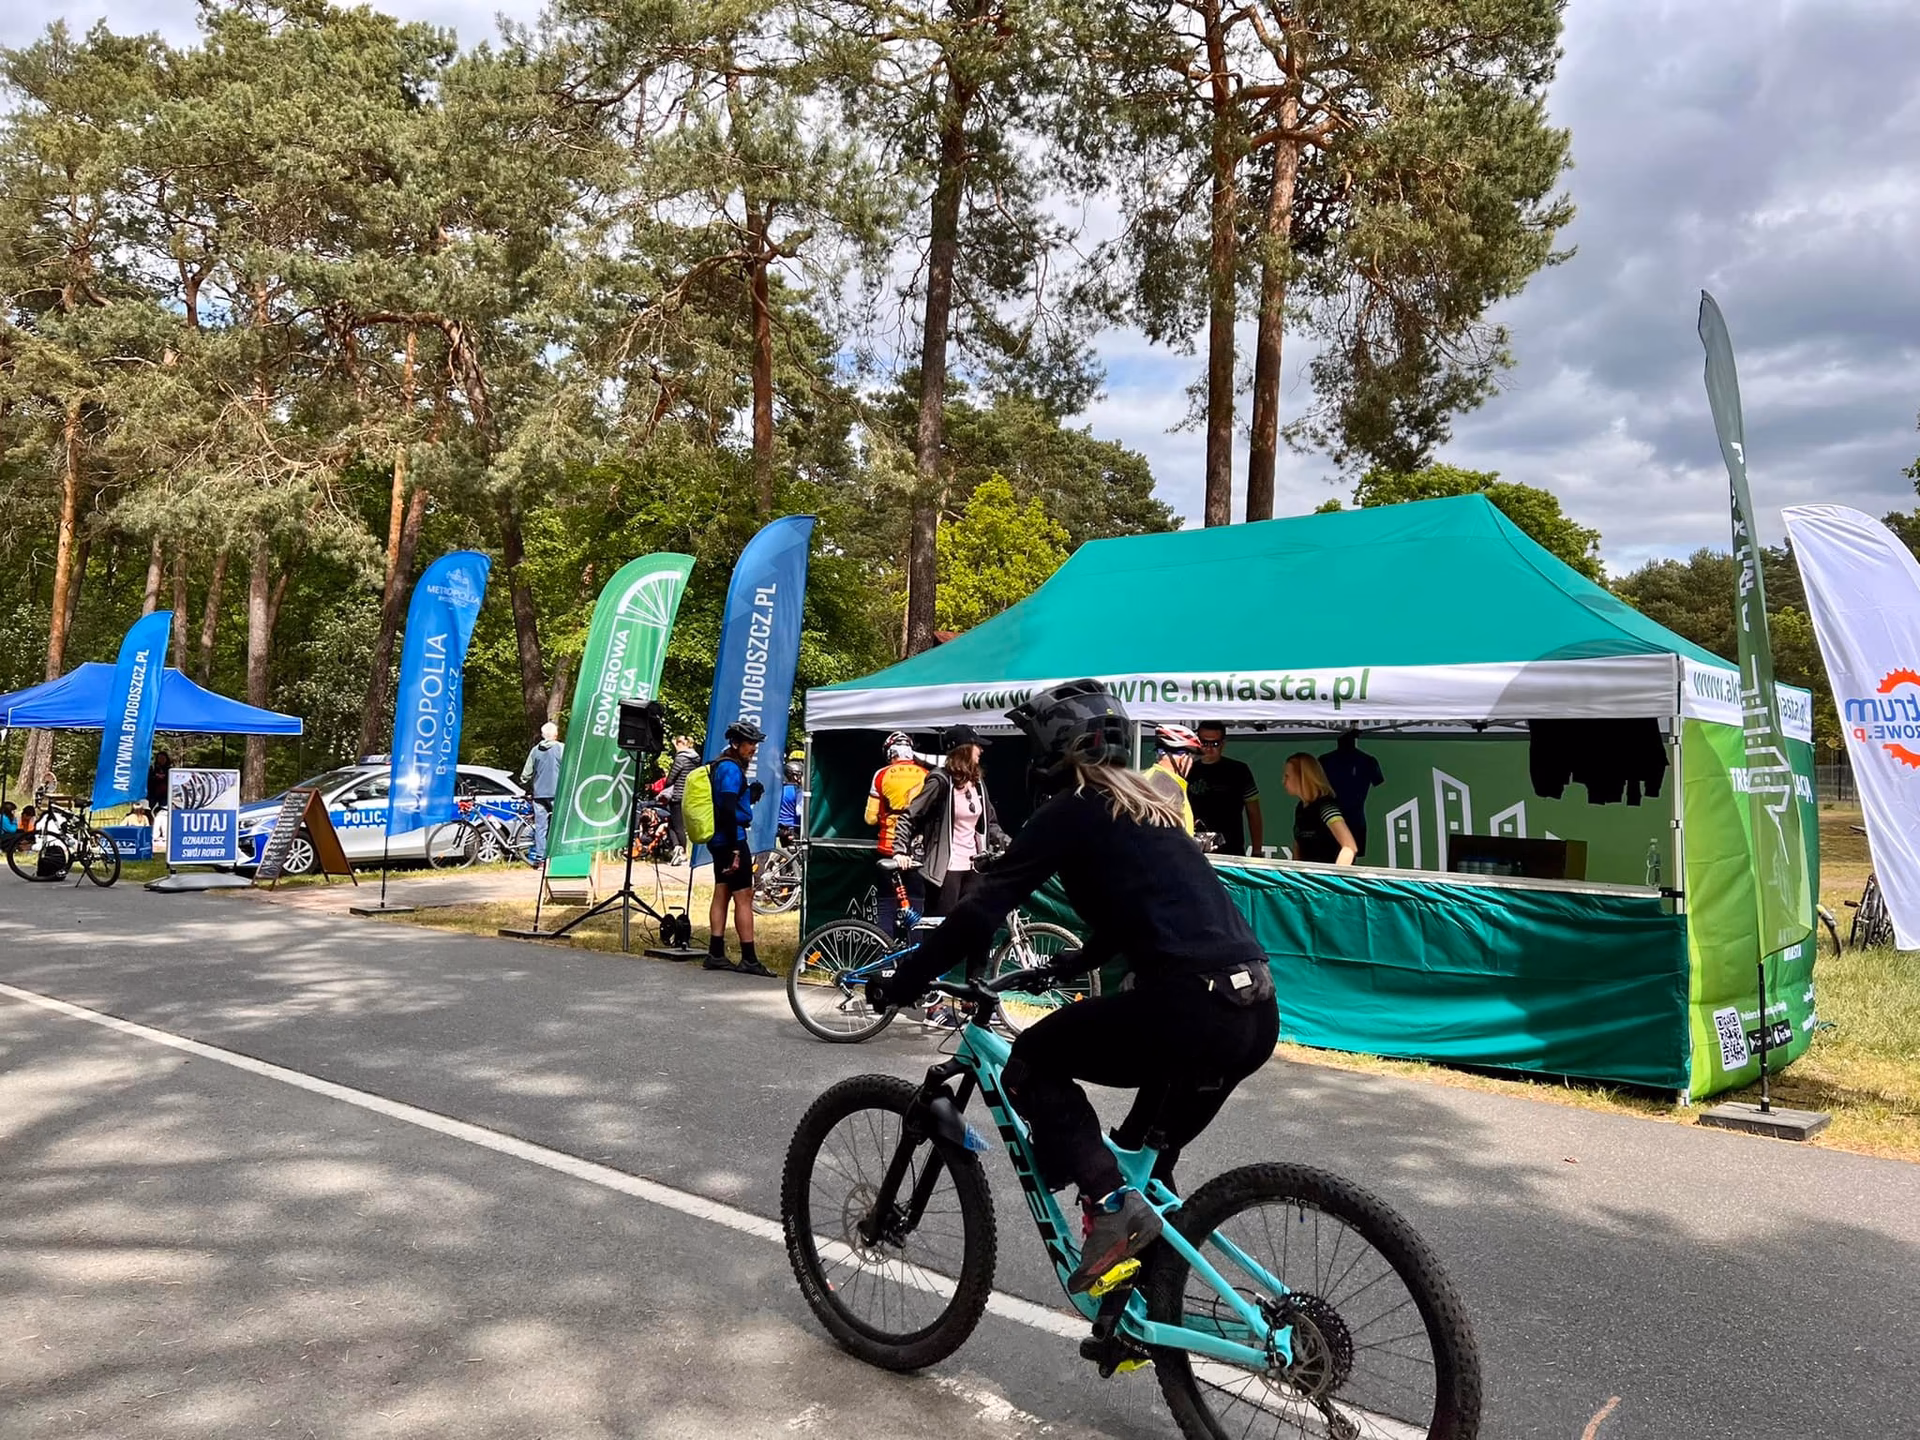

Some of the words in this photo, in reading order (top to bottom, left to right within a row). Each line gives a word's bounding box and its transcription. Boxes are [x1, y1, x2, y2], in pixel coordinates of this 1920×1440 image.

[112, 649, 150, 792] AKTYWNA.BYDGOSZCZ.PL
[592, 629, 631, 737] ROWEROWA
[961, 667, 1371, 710] wwwwne.miasta.pl
[435, 667, 460, 776] BYDGOSZCZ
[180, 812, 227, 832] TUTAJ
[182, 835, 226, 845] OZNAKUJESZ
[200, 847, 226, 858] ROWER
[984, 1073, 1074, 1281] TREK
